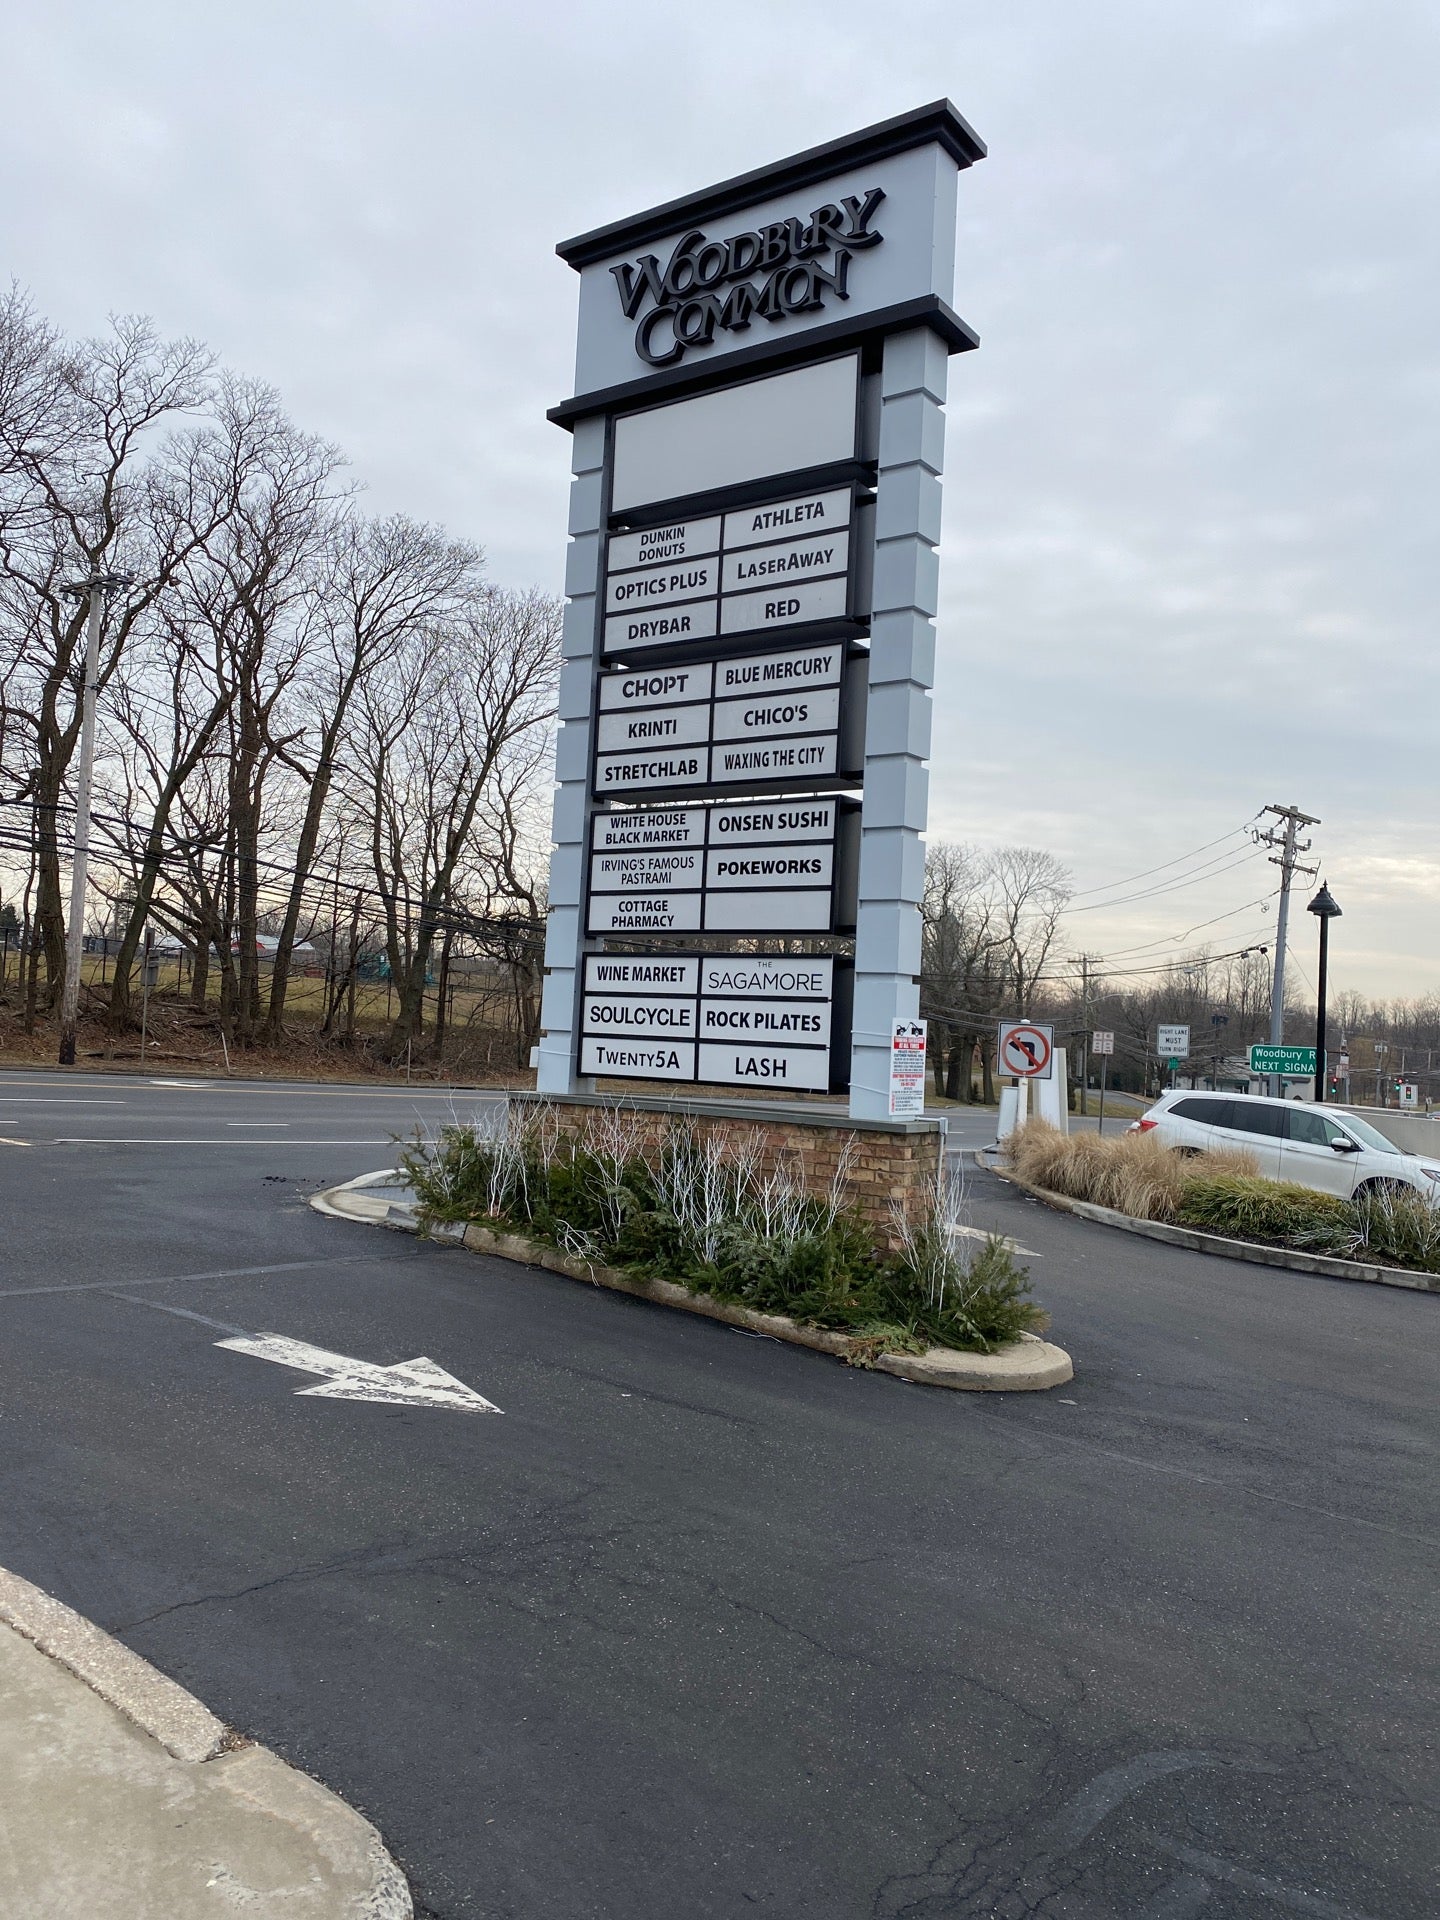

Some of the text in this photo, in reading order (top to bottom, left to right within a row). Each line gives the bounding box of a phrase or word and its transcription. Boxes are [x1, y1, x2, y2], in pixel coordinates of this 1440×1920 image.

[609, 187, 887, 320] WOODBURY
[634, 248, 853, 367] COMMON
[752, 502, 825, 531] ATHLETA
[640, 526, 685, 546] DUNKIN
[638, 542, 685, 562] DONUTS
[615, 570, 708, 601] OPTICS PLUS
[765, 599, 801, 619] RED
[628, 616, 691, 640] DRYBAR
[725, 656, 833, 685] BLUE MERCURY
[622, 674, 689, 698] CHOPT
[743, 704, 808, 727] CHICO'S
[628, 719, 677, 739] KRINTI
[724, 747, 825, 770] WAXING THE CITY
[605, 759, 698, 782] STRETCHLAB
[610, 813, 686, 829] WHITE HOUSE
[718, 810, 829, 832] ONSEN SUSHI
[605, 829, 690, 845] BLACK MARKET
[601, 856, 695, 872] IRVING'S FAMOUS
[717, 858, 822, 876] POKEWORKS
[621, 871, 672, 885] PASTRAMI
[618, 900, 669, 913] COTTAGE
[611, 915, 675, 928] PHARMACY
[597, 965, 686, 982] WINE MARKET
[708, 971, 823, 991] SAGAMORE
[590, 1005, 691, 1027] SOULCYCLE
[706, 1010, 821, 1032] ROCK PILATES
[1255, 1048, 1316, 1060] Woodbury R
[735, 1056, 787, 1078] LASH
[1254, 1061, 1316, 1073] NEXT SIGNA
